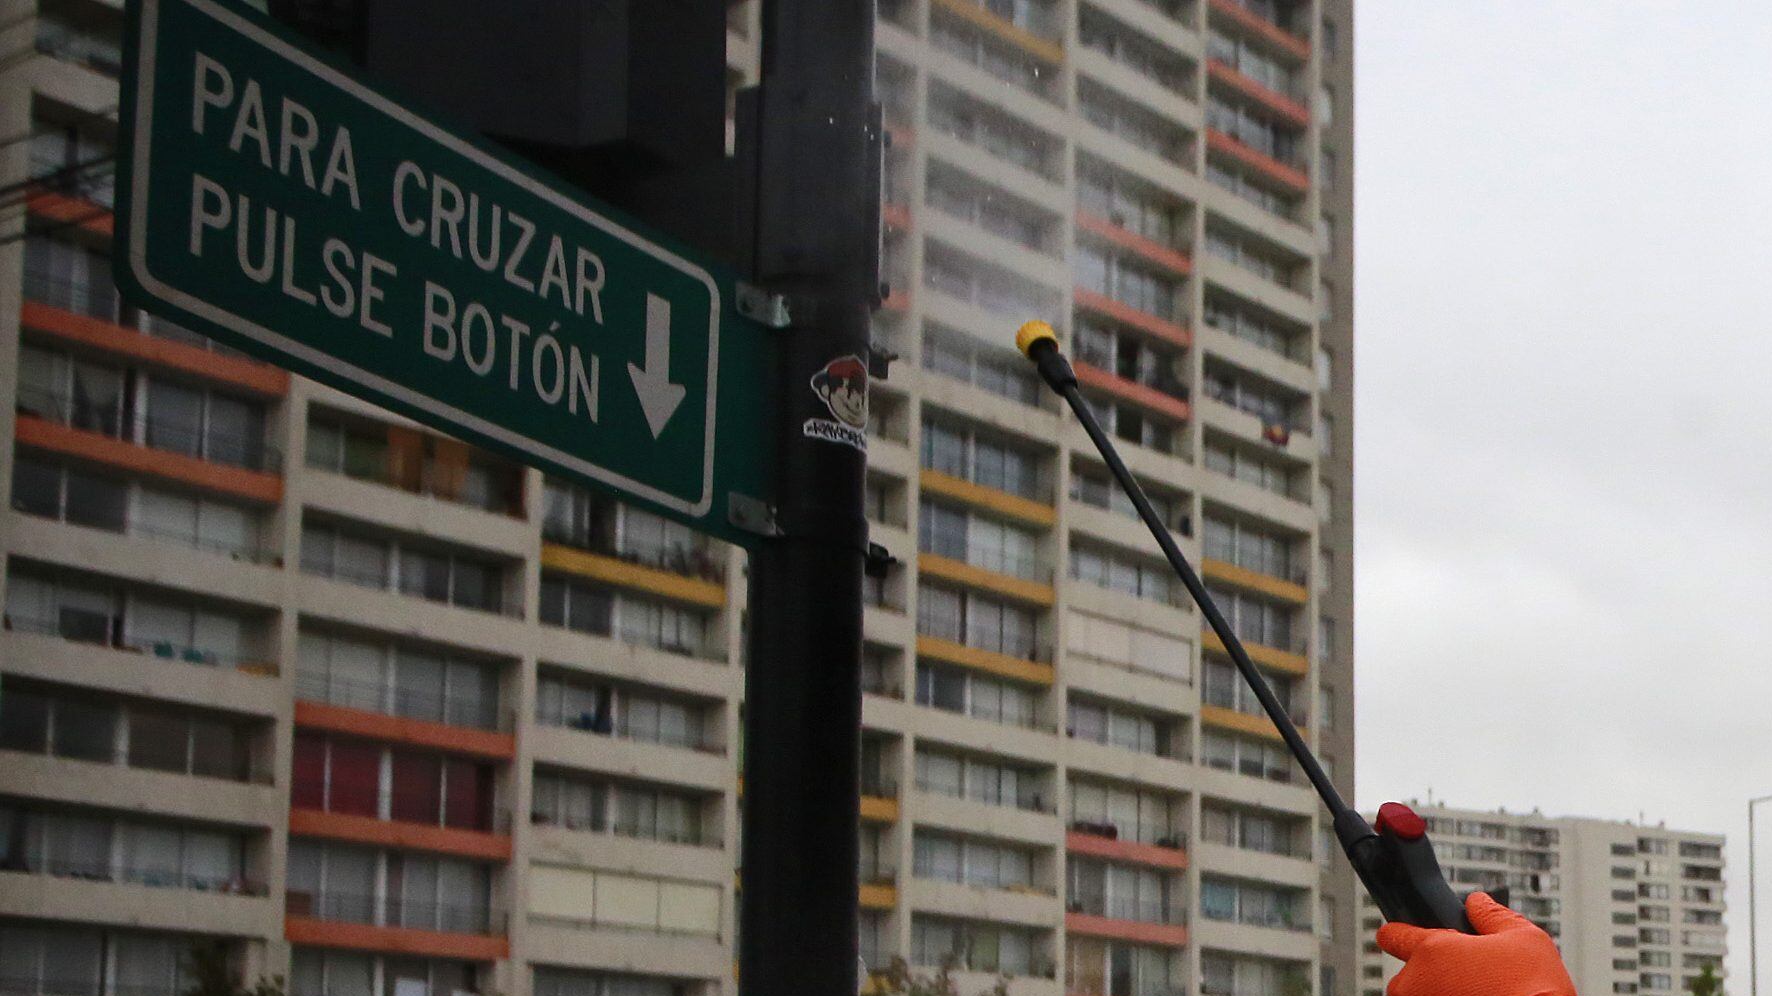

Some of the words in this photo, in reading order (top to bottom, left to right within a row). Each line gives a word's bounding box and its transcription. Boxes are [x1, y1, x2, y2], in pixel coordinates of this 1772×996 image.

[190, 173, 397, 338] PULSE
[423, 279, 600, 424] BOTÓN
[193, 51, 361, 211] PARA
[393, 160, 606, 325] CRUZAR
